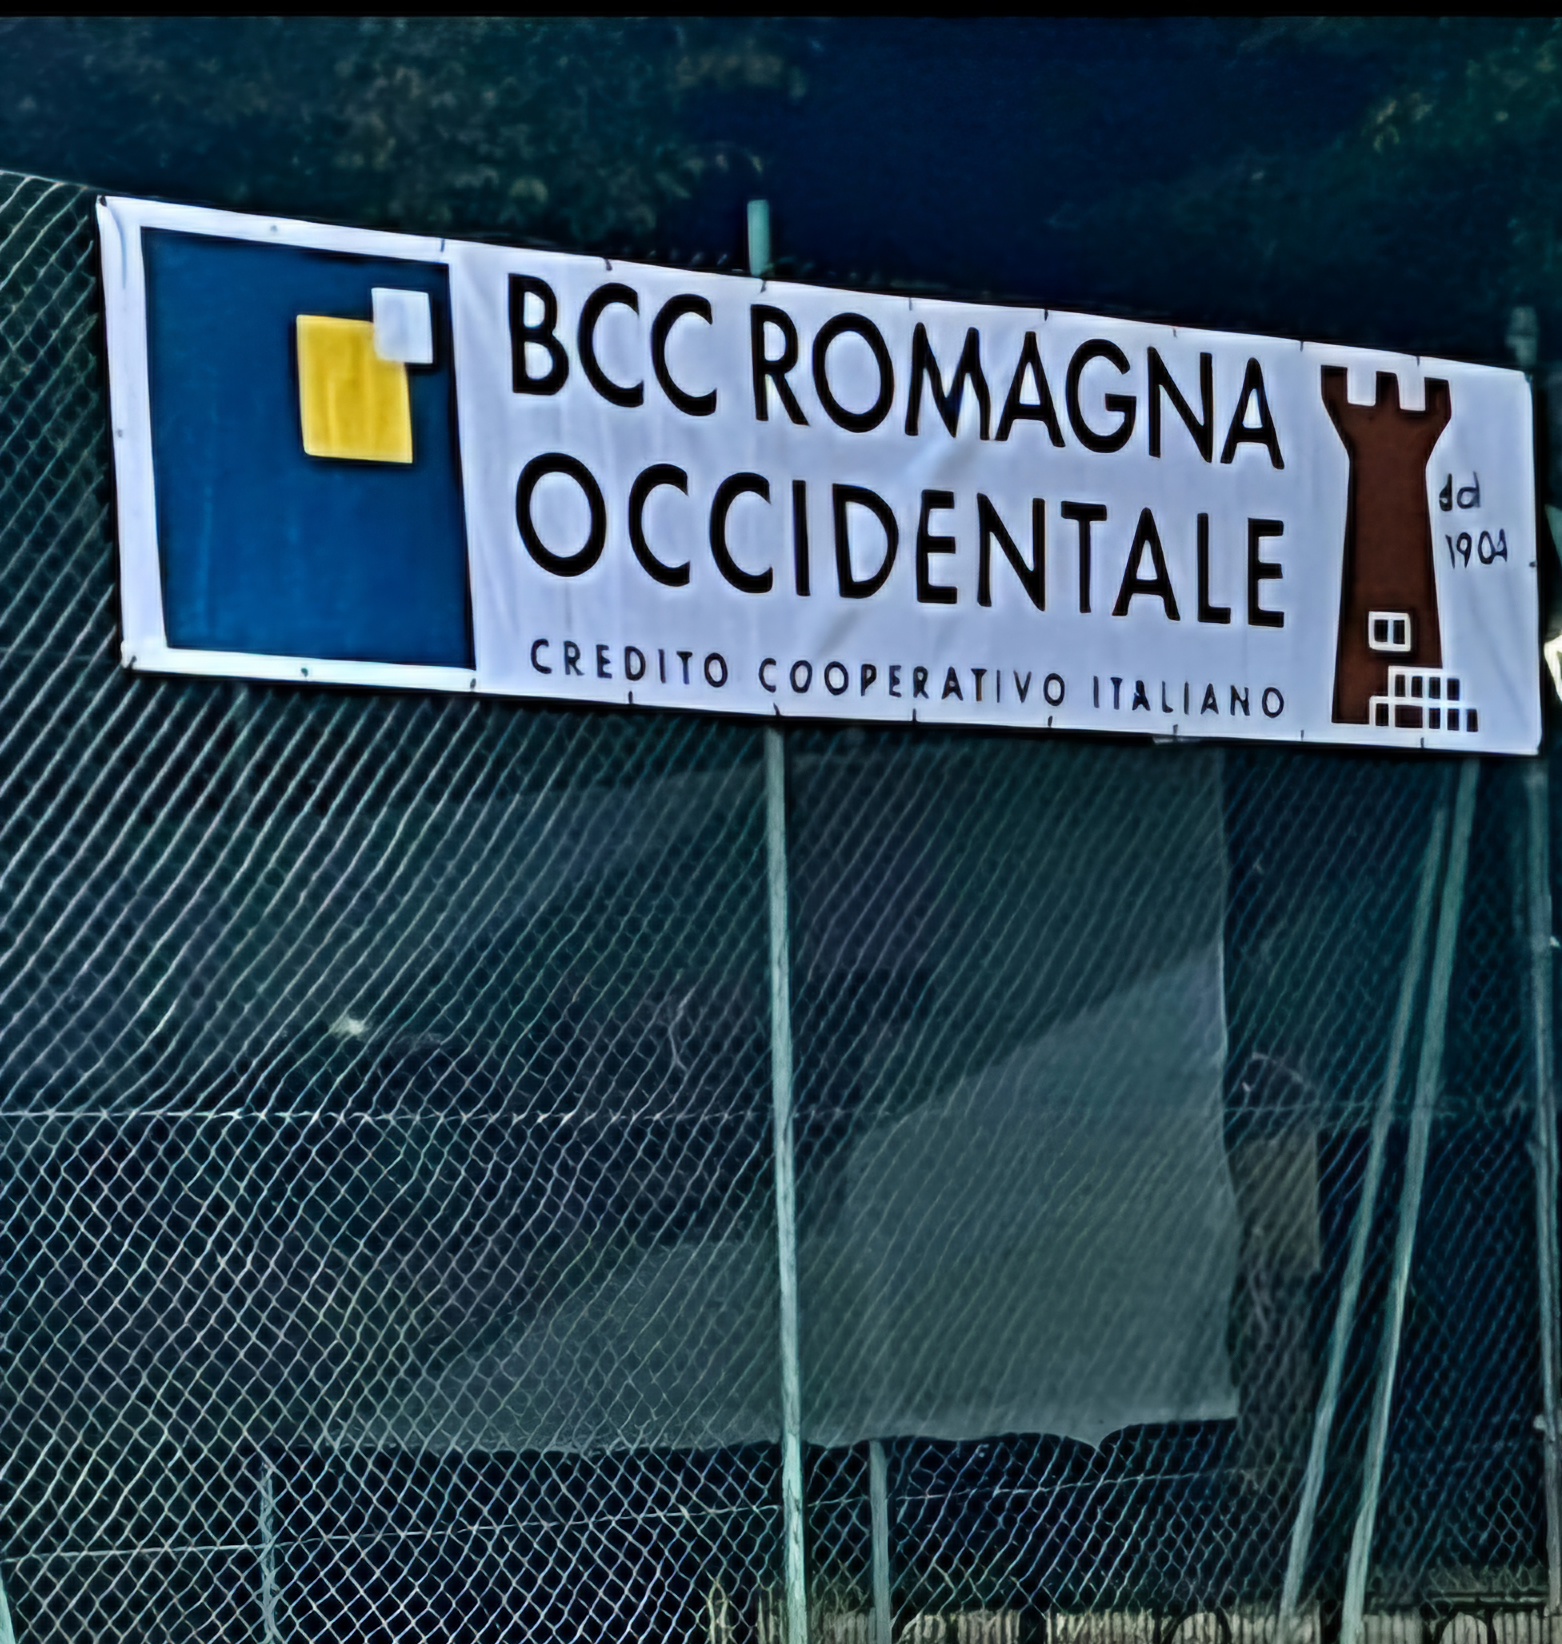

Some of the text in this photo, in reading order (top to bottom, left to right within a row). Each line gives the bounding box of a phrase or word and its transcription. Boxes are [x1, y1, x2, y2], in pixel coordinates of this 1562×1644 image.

[507, 272, 1285, 470] BCC ROMAGNA
[515, 452, 1285, 629] OCCIDENTALE
[1445, 528, 1508, 569] 1904
[530, 638, 1285, 719] CREDITO COOPERATIVO ITALIANO
